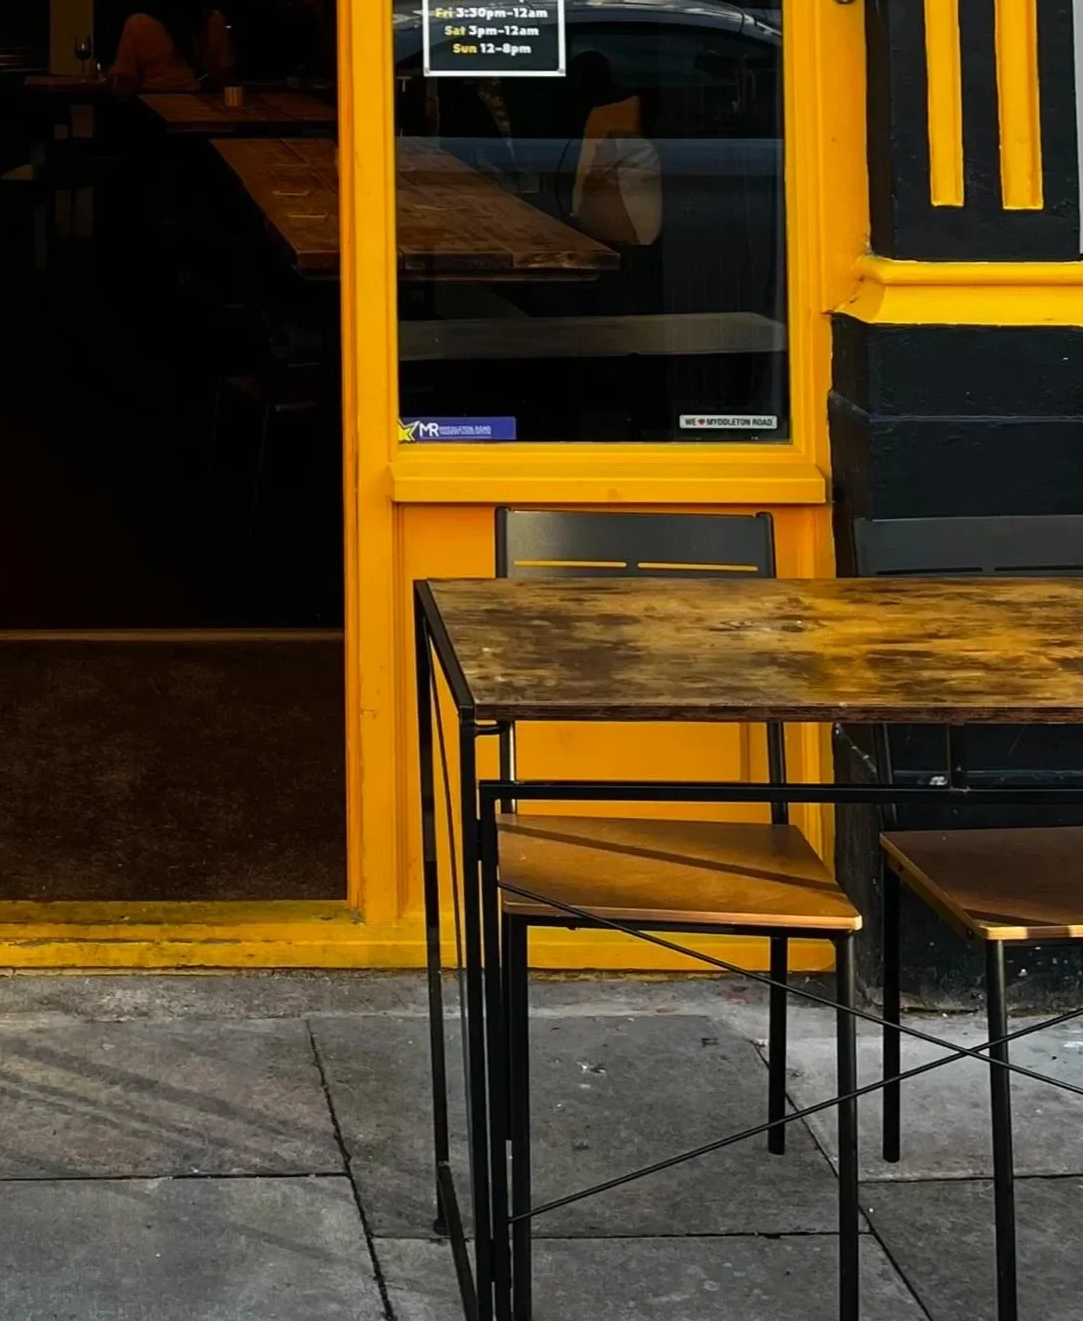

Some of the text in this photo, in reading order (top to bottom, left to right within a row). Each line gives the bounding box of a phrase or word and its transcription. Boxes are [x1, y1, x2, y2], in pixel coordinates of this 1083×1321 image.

[434, 7, 548, 21] Fri 3:30pm-12am
[444, 25, 540, 39] Sat 3pm-12am
[452, 43, 532, 57] Sun 12-8pm
[419, 422, 439, 437] MR
